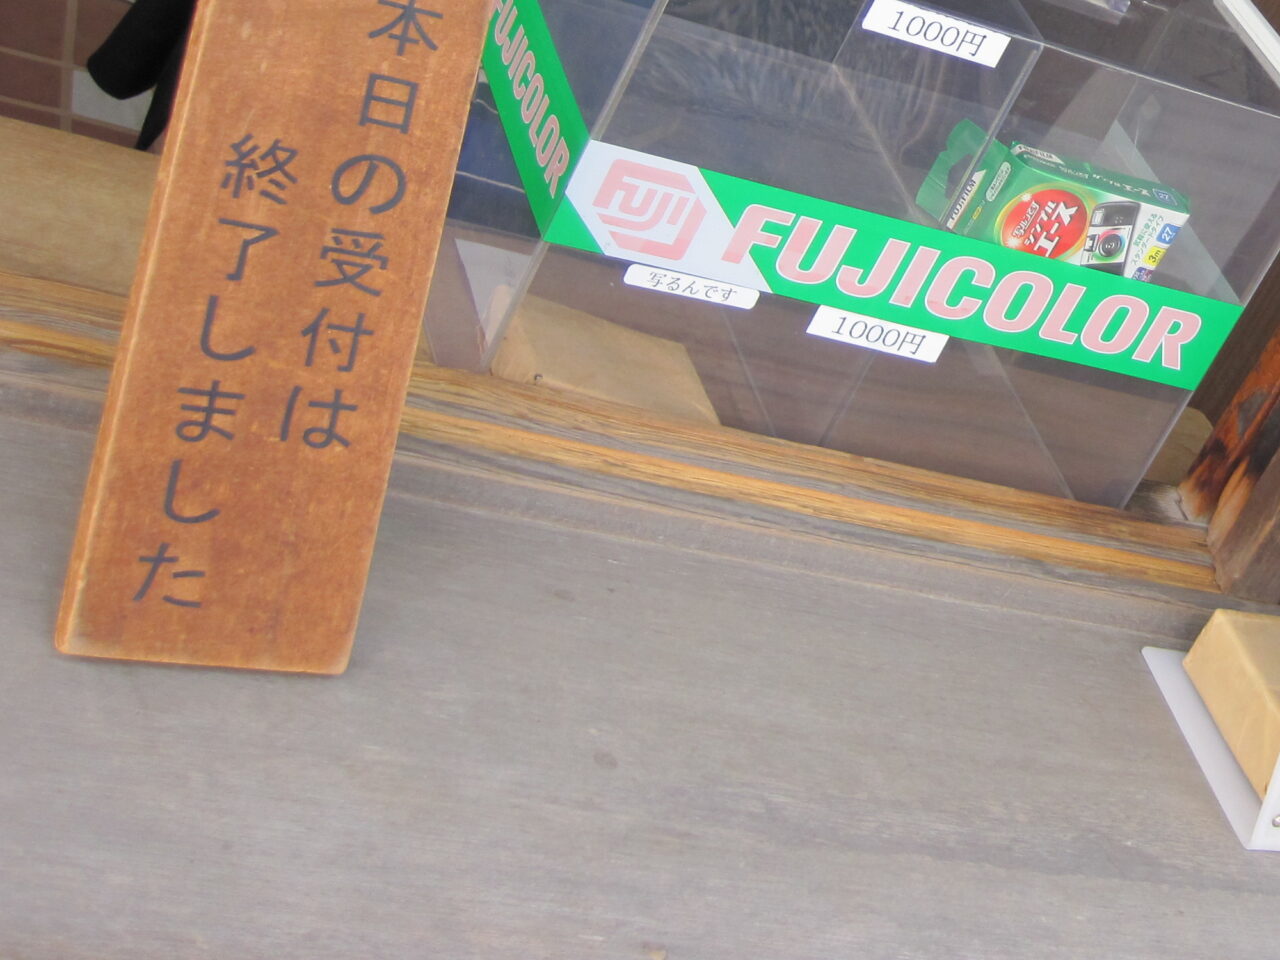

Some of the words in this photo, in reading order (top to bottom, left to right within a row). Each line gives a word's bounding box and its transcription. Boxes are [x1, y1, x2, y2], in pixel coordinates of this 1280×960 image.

[888, 10, 987, 57] 1000円
[1162, 226, 1176, 243] 27
[1148, 249, 1162, 264] 3m
[647, 270, 738, 303] 写るんです
[722, 203, 1202, 371] FUJICOLOR
[832, 316, 927, 357] 1000円
[132, 132, 301, 608] 終了しました
